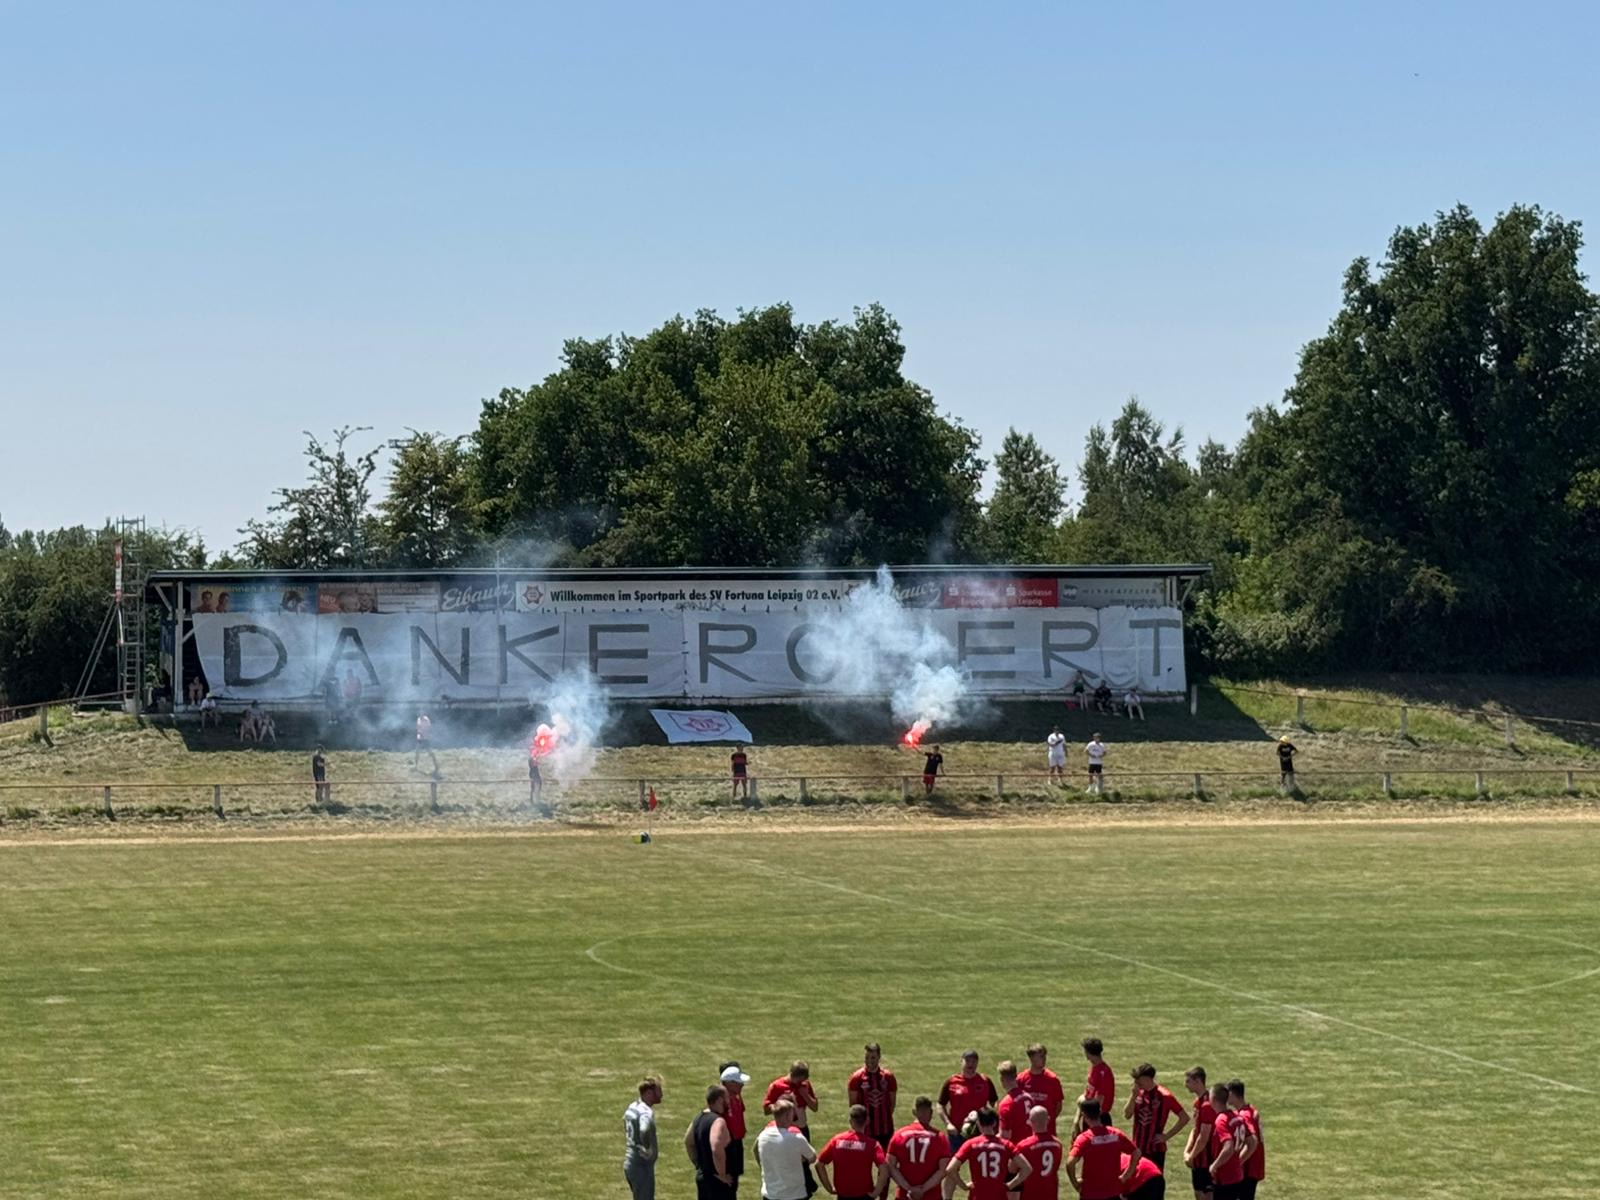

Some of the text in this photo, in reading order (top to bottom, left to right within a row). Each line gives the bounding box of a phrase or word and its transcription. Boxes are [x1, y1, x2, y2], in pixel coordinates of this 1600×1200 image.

[441, 582, 515, 610] Eibauer
[550, 588, 841, 603] Willkommen im Sportpark des SV Fortuna Leipzig 02 e.V.
[889, 582, 941, 608] bauer
[1018, 588, 1052, 597] Sparkasse
[1018, 596, 1042, 606] Leipzig
[698, 619, 1181, 684] ROERT
[905, 1137, 931, 1163] 17
[1040, 1149, 1054, 1177] 9
[976, 1150, 1001, 1178] 13
